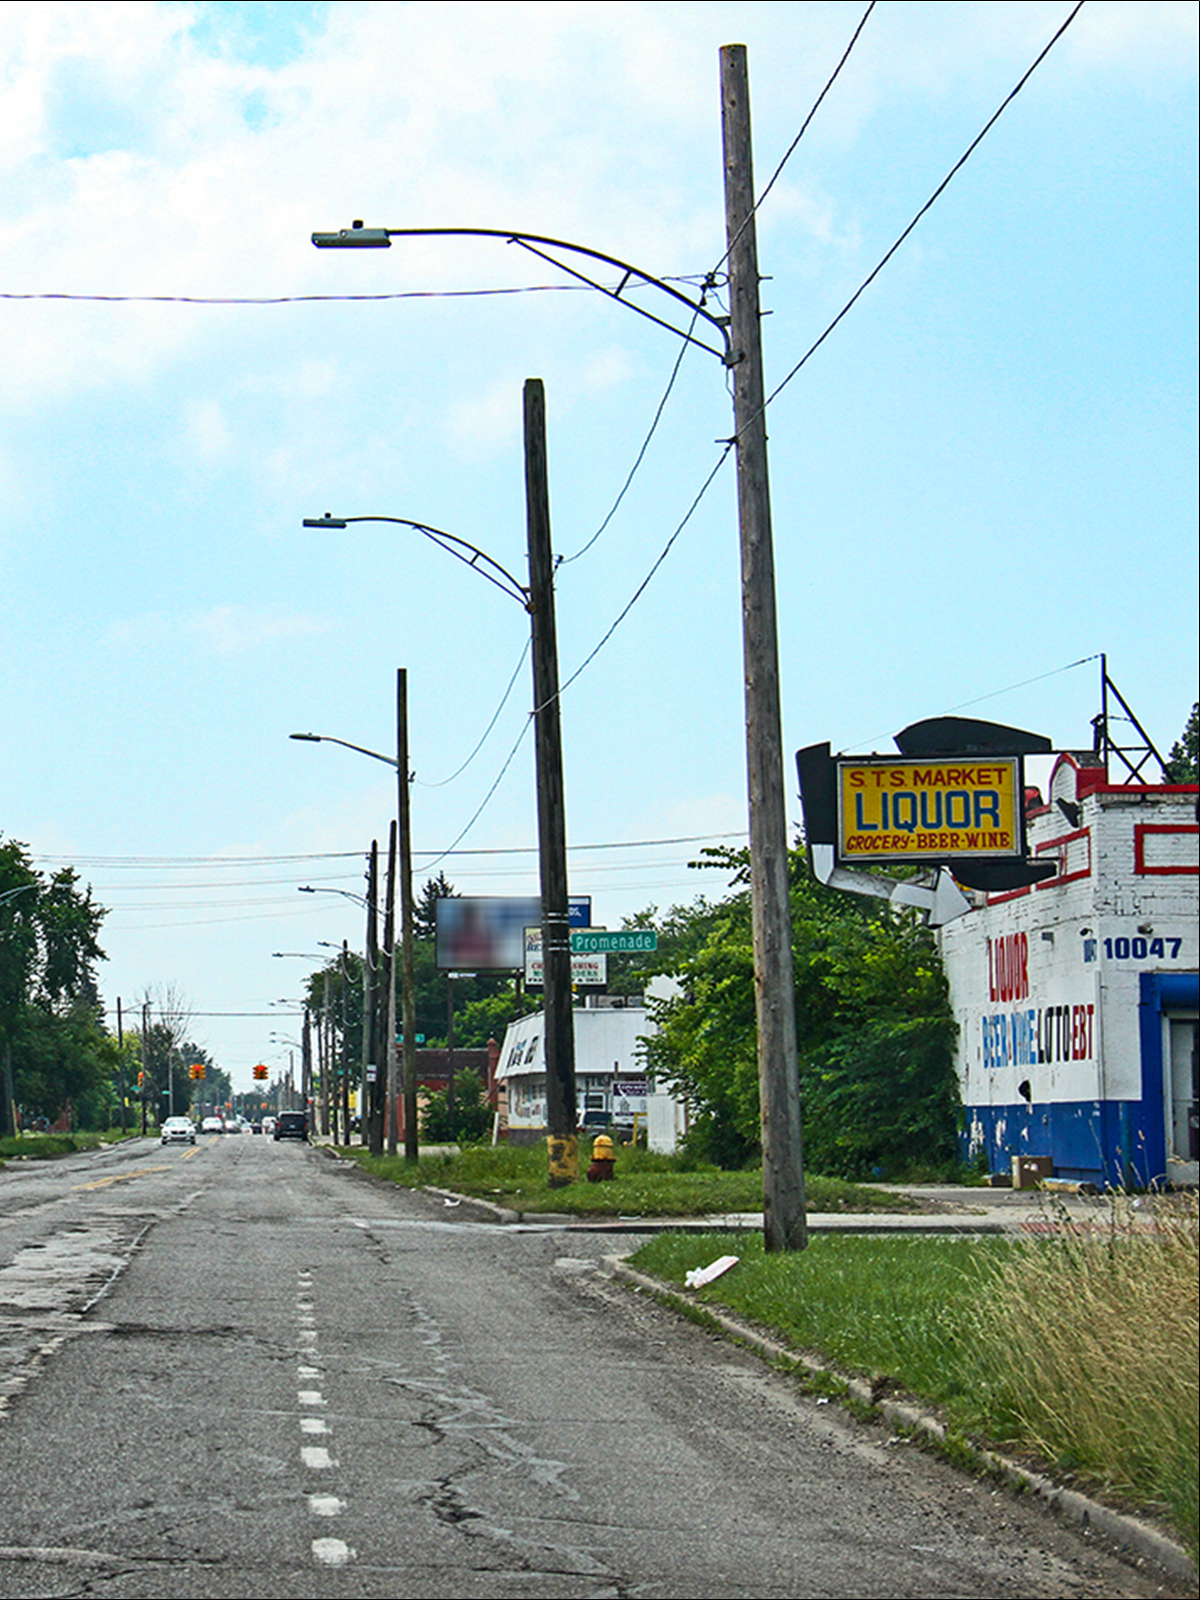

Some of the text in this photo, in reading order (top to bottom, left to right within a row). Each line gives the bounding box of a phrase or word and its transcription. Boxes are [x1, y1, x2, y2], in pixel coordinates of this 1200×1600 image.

[913, 768, 1007, 787] MARKET
[855, 790, 1000, 833] LIQUOR
[576, 935, 652, 950] Promenade
[1103, 937, 1183, 959] 10047
[988, 932, 1029, 1002] LIQUOR
